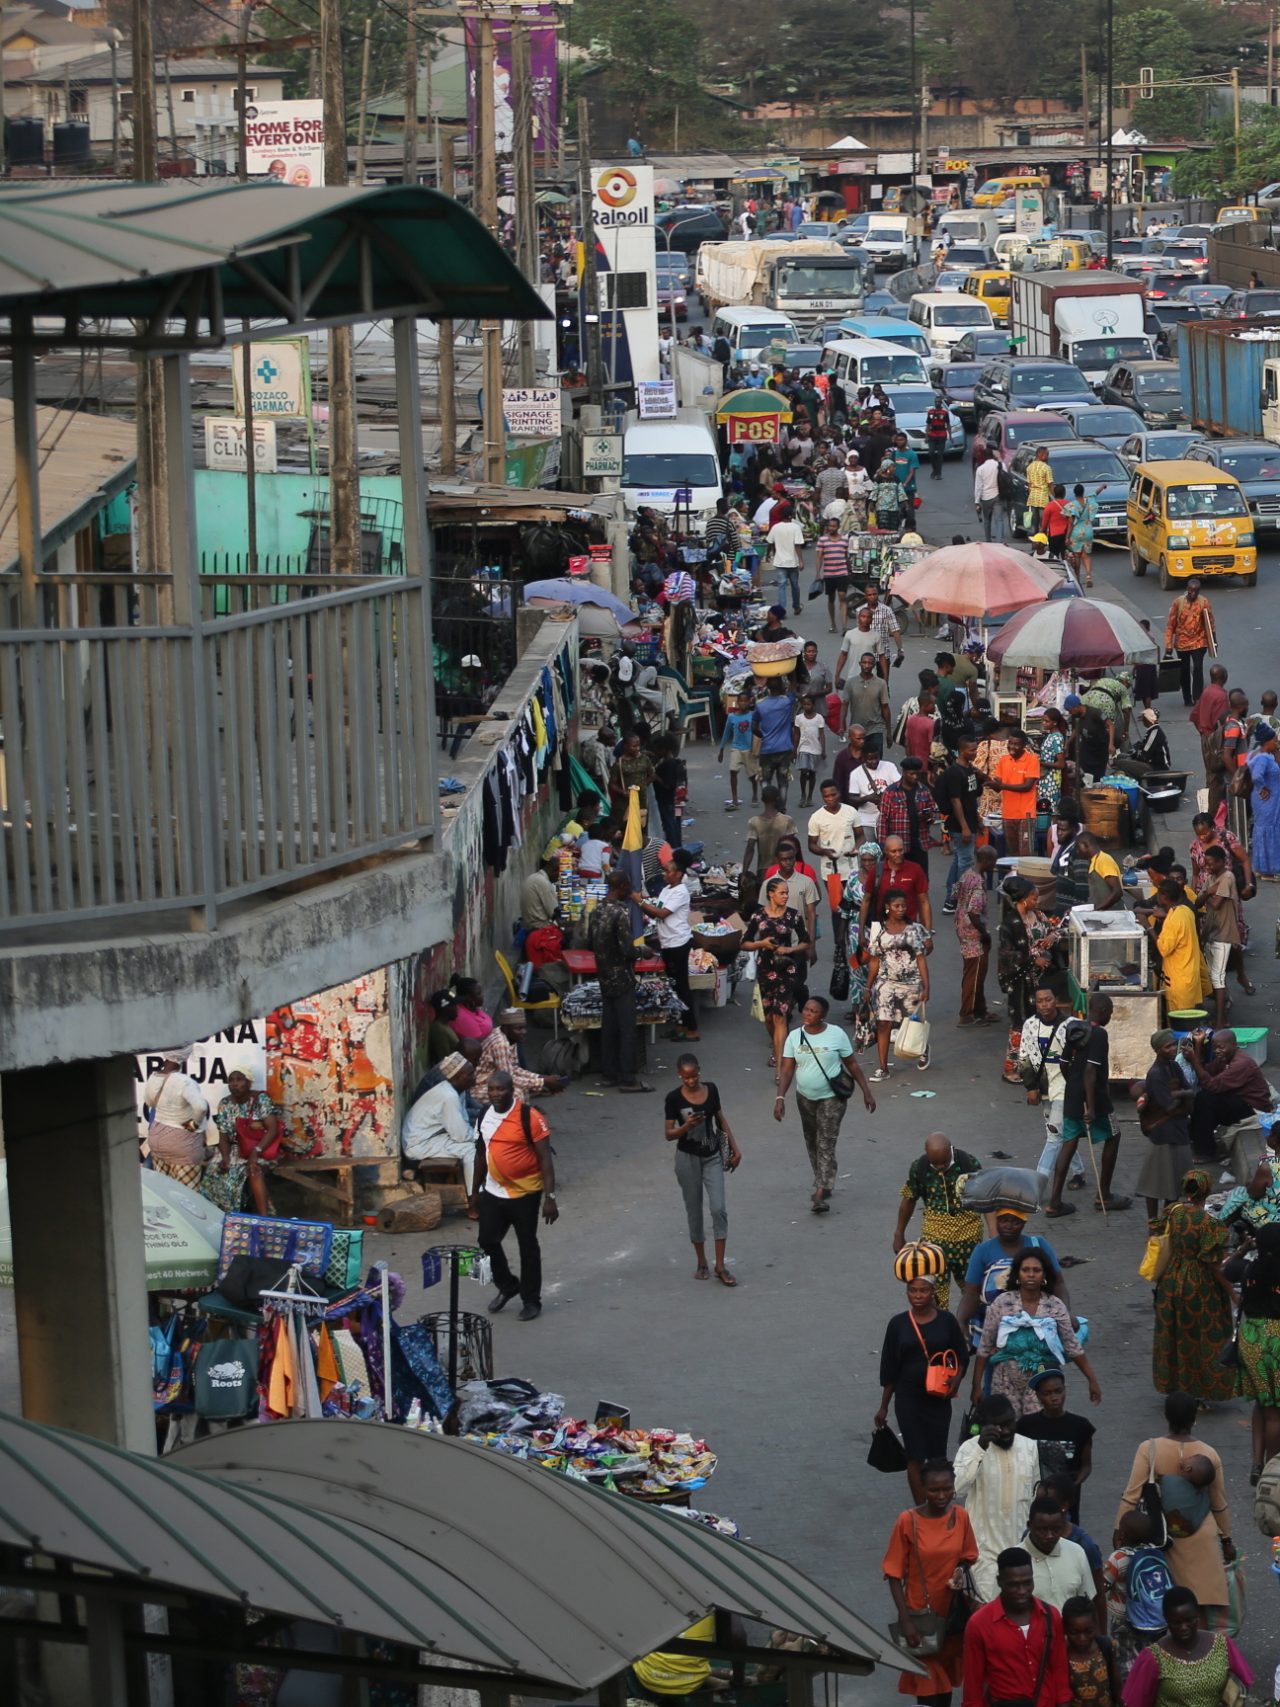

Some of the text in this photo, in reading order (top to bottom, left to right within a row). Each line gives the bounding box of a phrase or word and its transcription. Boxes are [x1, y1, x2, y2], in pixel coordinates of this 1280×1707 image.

[247, 120, 322, 134] HOME FOR
[244, 132, 325, 147] EVERYONE
[945, 160, 969, 170] POS
[592, 207, 648, 225] Rainoil
[251, 391, 288, 400] ROZACO
[251, 401, 295, 412] HARMACY
[213, 425, 265, 442] EYE
[735, 420, 776, 440] POS
[213, 441, 266, 459] CLINC
[585, 461, 620, 471] PHARMACY
[175, 1269, 209, 1278] Network
[211, 1379, 242, 1388] Roots
